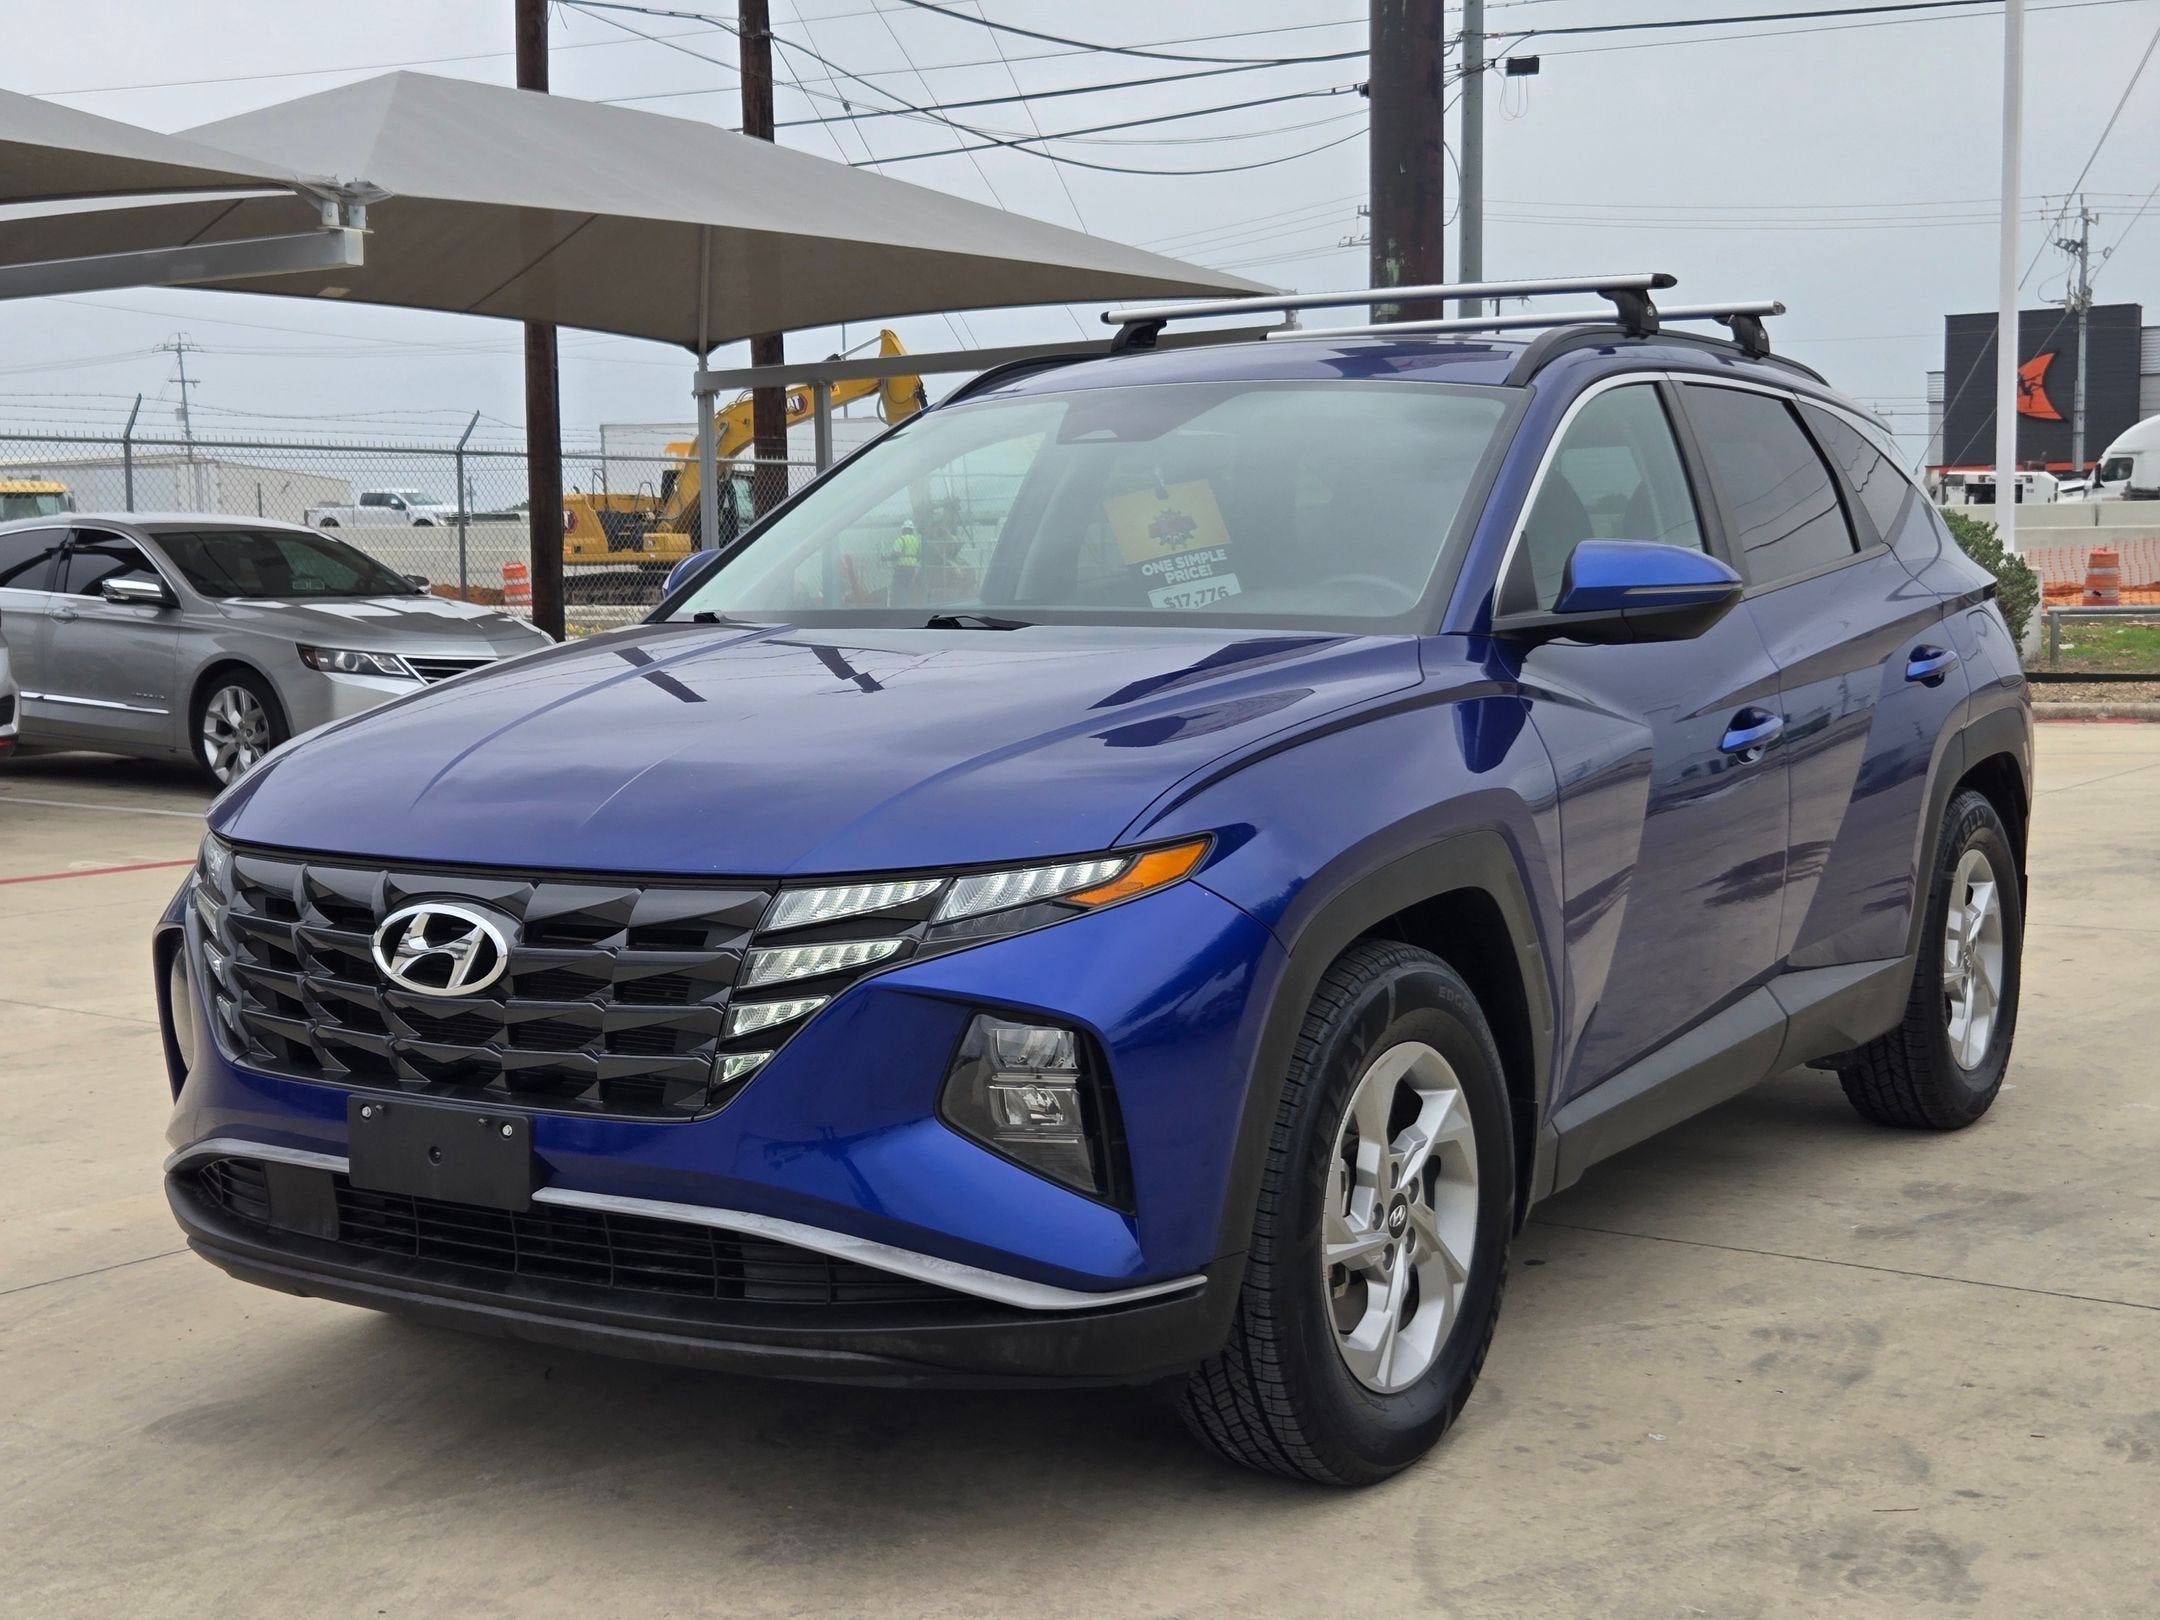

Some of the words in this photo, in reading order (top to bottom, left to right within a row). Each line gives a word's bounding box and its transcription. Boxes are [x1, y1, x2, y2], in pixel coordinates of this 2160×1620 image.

[1142, 559, 1174, 576] ONE
[1175, 549, 1228, 568] SIMPLE
[1164, 565, 1213, 584] PRICE!
[1163, 586, 1228, 608] $17,776
